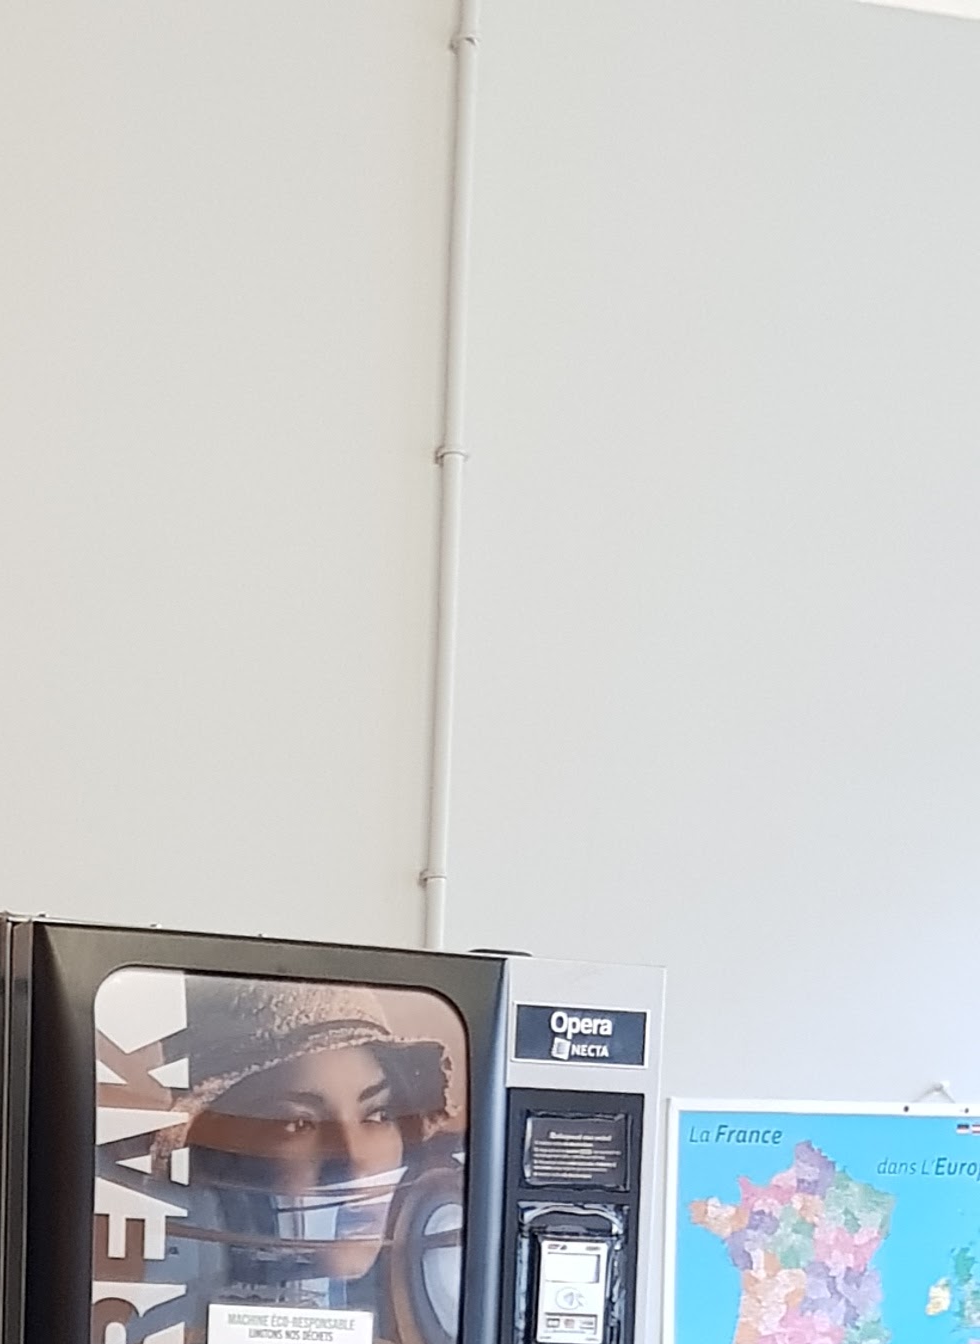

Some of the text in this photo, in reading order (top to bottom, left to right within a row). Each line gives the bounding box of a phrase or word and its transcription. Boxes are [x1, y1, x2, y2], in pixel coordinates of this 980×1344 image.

[550, 1011, 613, 1039] Opera
[571, 1044, 610, 1058] NECTA
[689, 1124, 783, 1145] La France
[877, 1156, 980, 1181] dans L'Euro
[228, 1313, 268, 1326] MACHINE
[248, 1328, 333, 1341] LIMITONS NOS DÉCHETS
